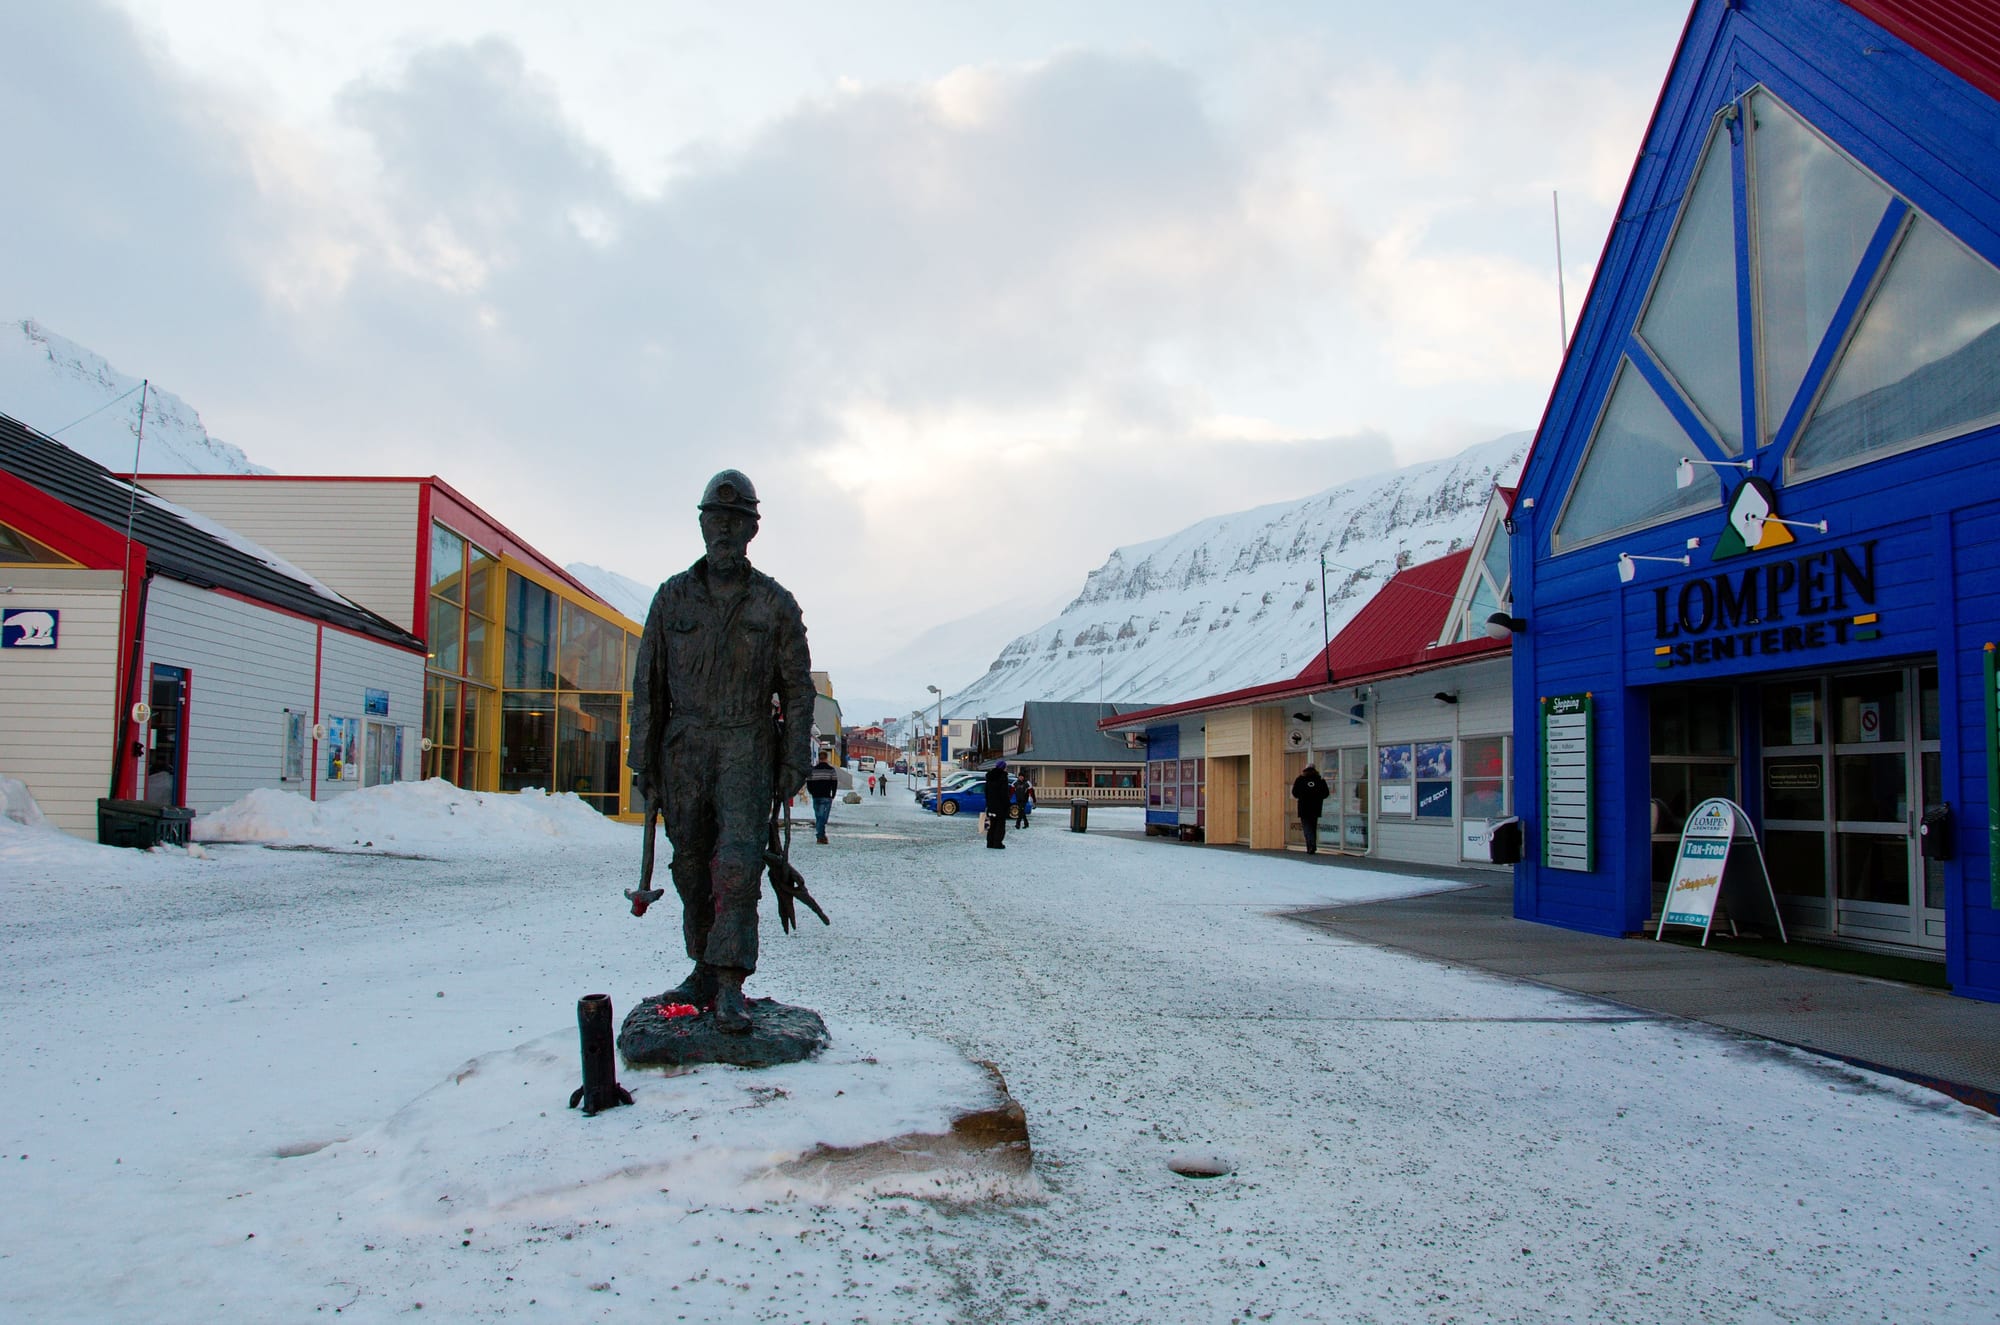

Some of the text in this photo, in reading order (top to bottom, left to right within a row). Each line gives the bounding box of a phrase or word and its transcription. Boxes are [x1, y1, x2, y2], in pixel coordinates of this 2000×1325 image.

[1653, 540, 1878, 640] LOMPEN
[1675, 617, 1854, 666] SENTERET
[1694, 817, 1728, 826] LOMPEN
[1686, 842, 1725, 856] Tax-Free
[1669, 914, 1708, 924] WELCOME
